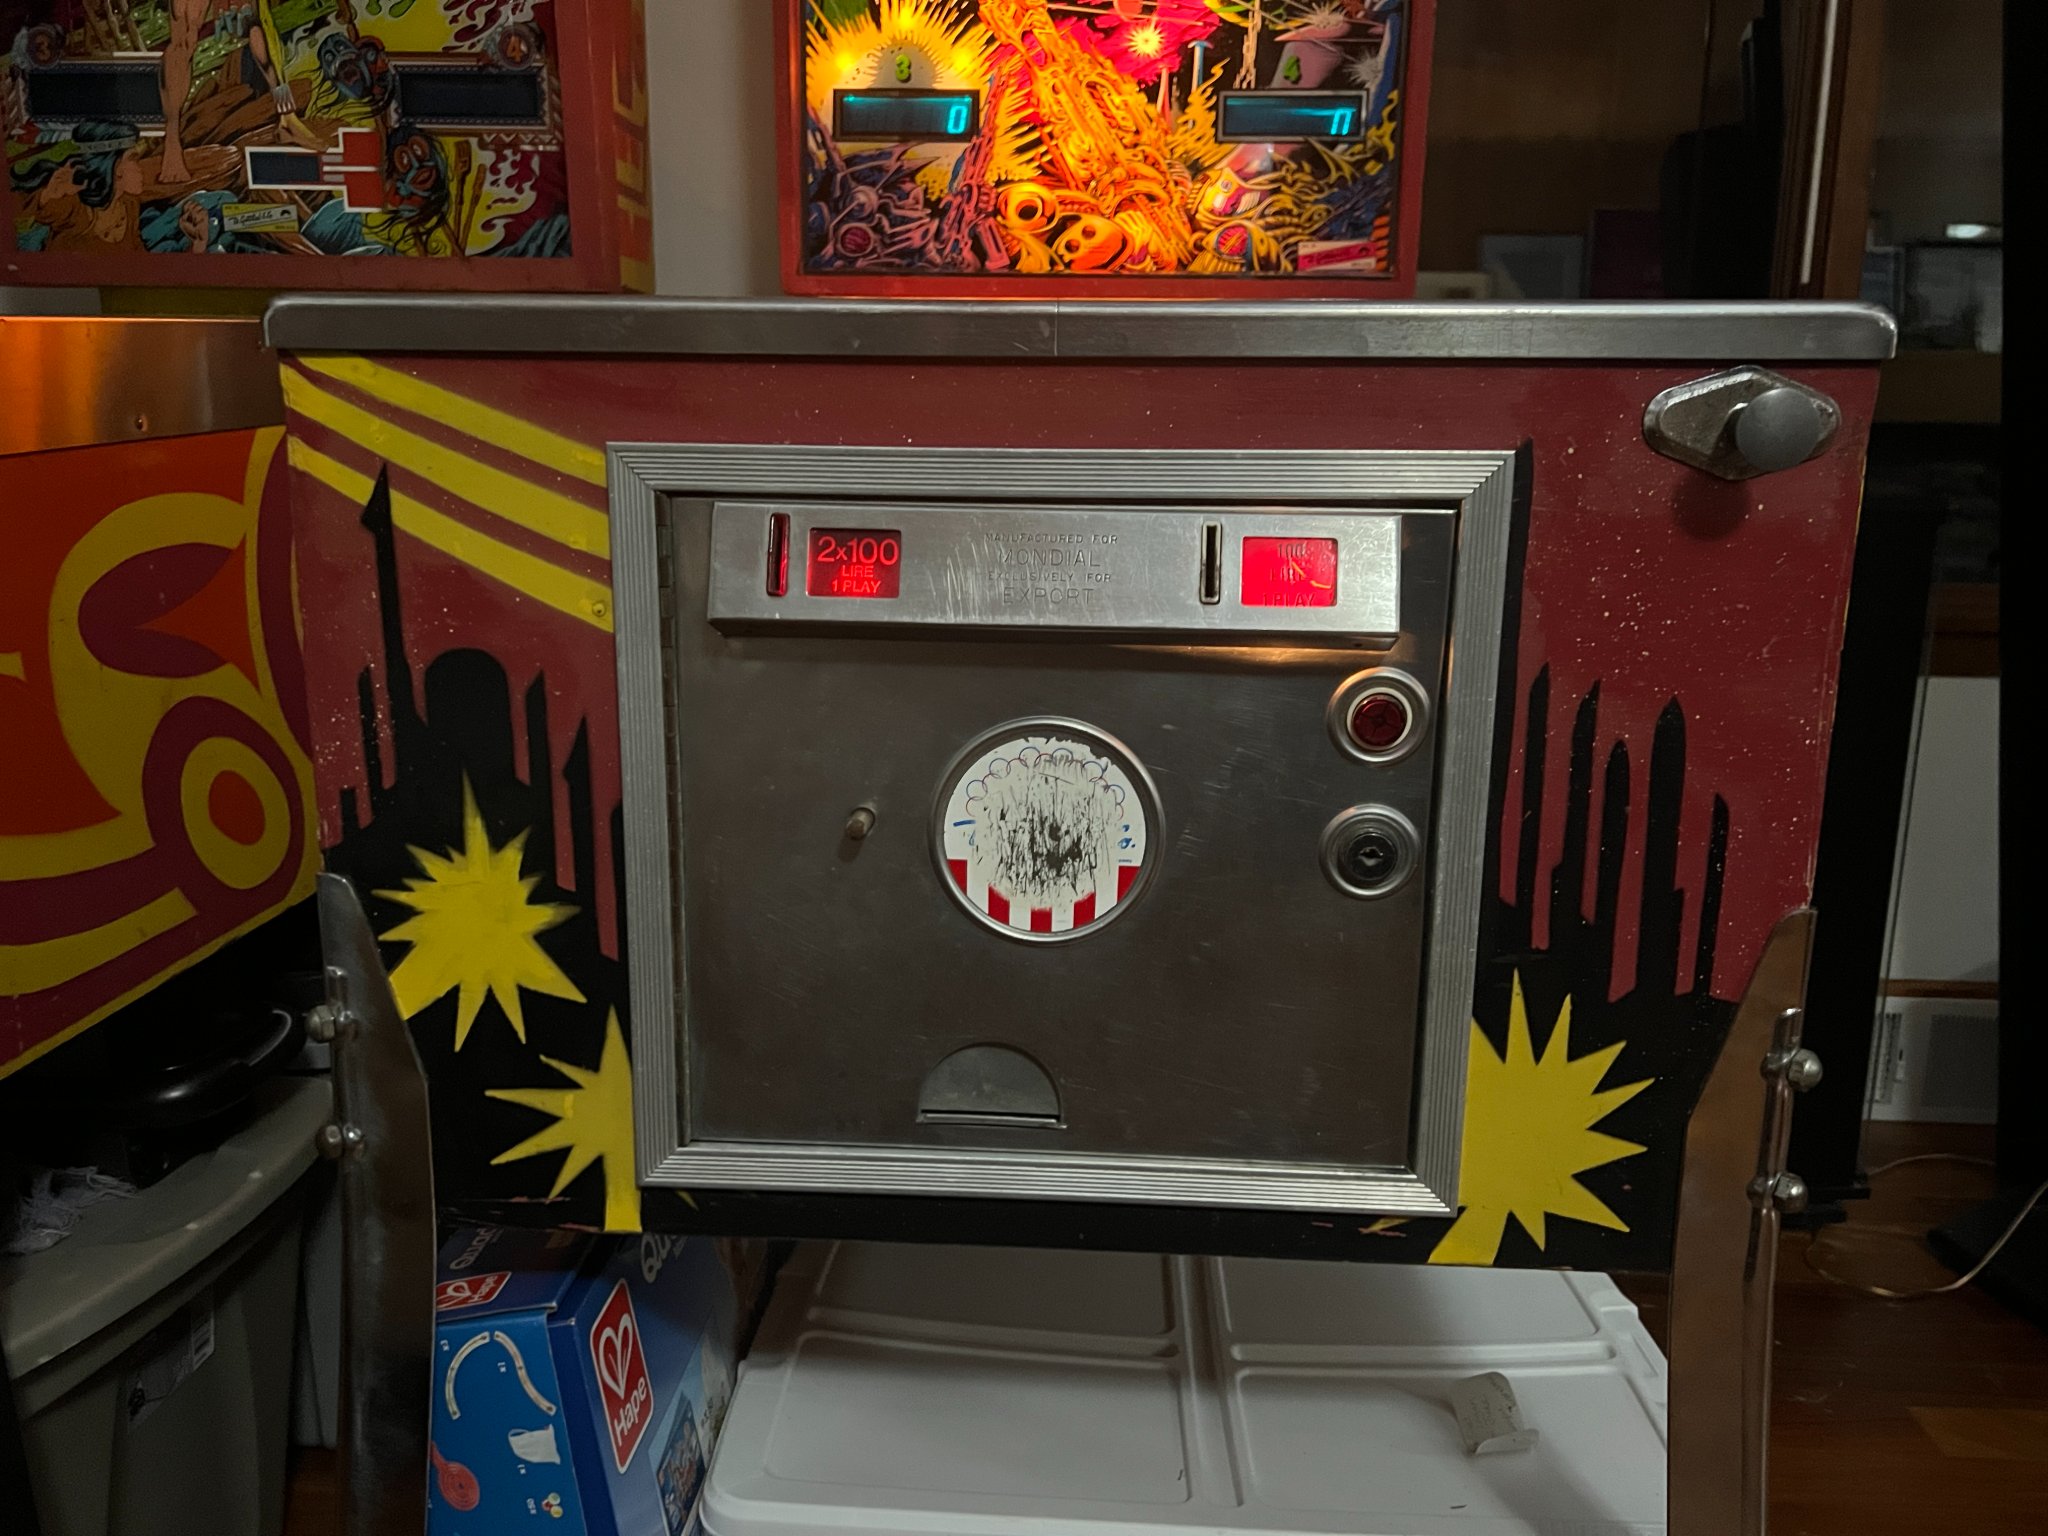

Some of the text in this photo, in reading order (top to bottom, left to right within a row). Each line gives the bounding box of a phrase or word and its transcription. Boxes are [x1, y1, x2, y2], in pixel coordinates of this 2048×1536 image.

[895, 54, 911, 82] 3
[947, 105, 968, 134] 0
[983, 532, 1118, 544] MANUFACTURED FOR
[817, 536, 899, 566] 2x100
[1000, 548, 1101, 567] MONDIAL
[842, 565, 874, 577] LIRE
[988, 570, 1112, 582] EXCLUSIVELY FOR
[832, 579, 882, 593] 1 PLAY
[1003, 586, 1095, 604] EXPORT
[1273, 593, 1316, 607] PLAY
[614, 1376, 647, 1446] Hape
